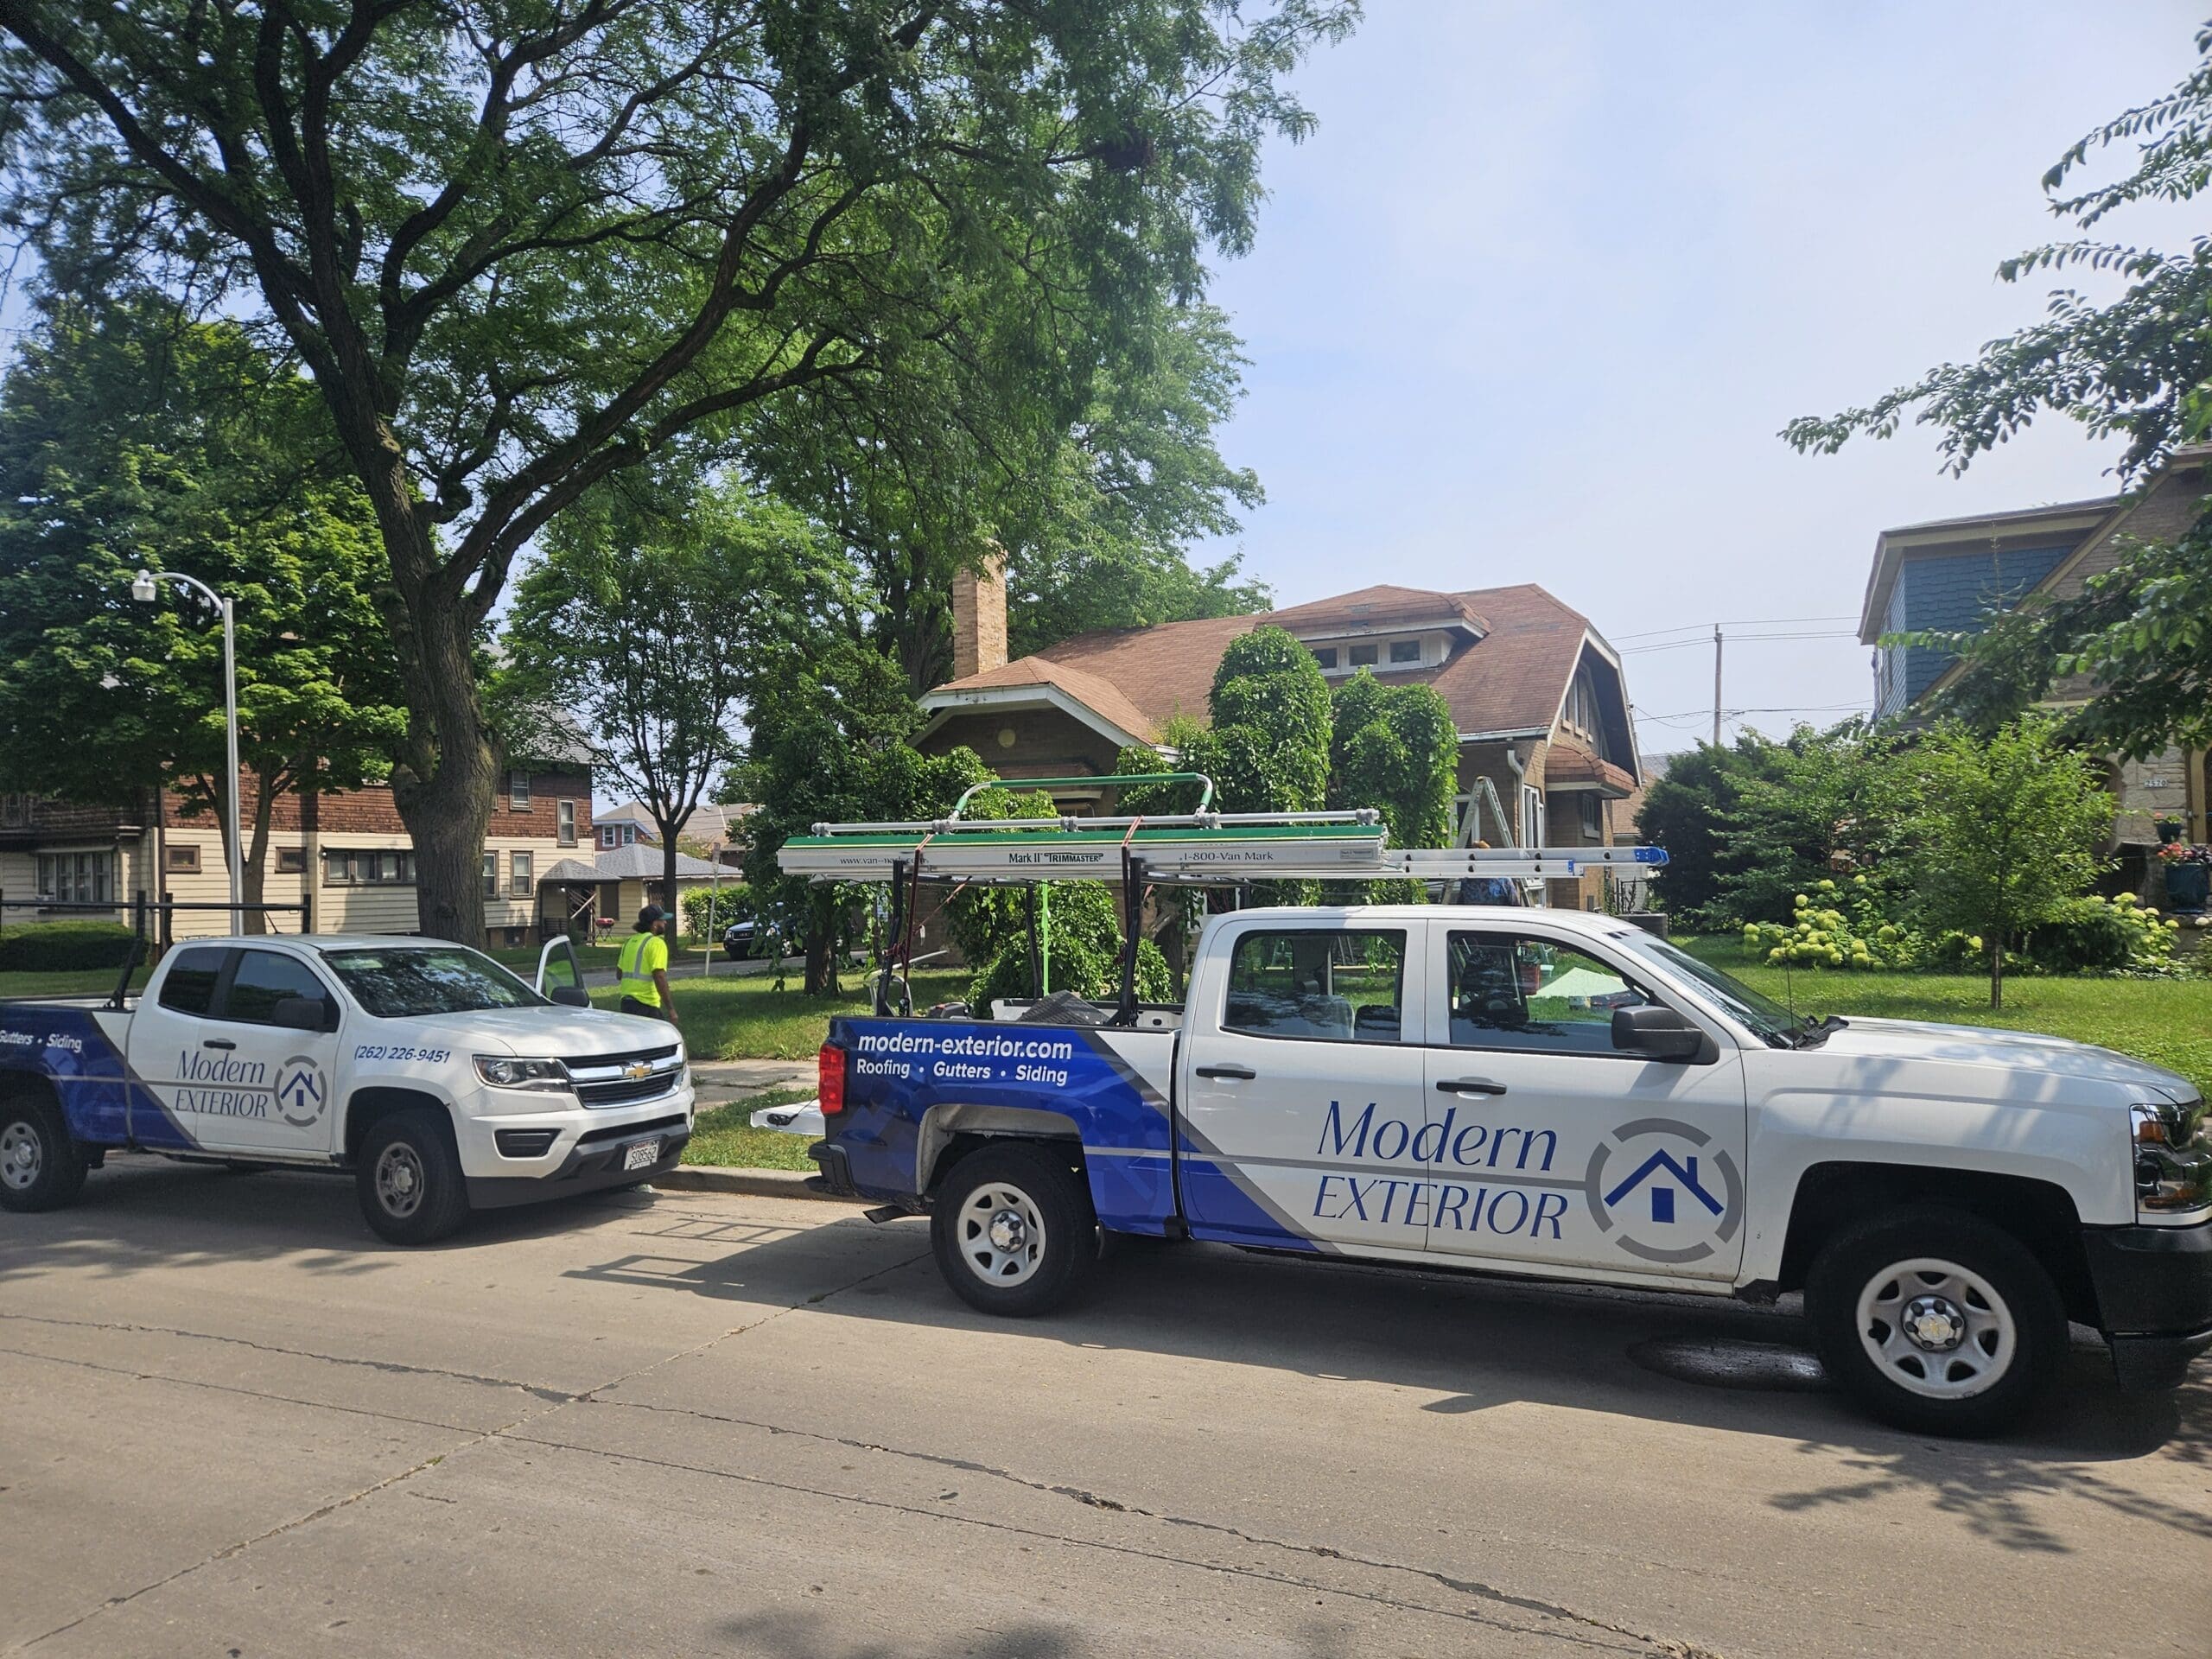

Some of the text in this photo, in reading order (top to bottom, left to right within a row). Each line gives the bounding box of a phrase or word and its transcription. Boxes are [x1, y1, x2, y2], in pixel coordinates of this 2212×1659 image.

[1008, 853, 1032, 863] Mark
[1184, 851, 1274, 861] 1-800-Van Mark
[0, 1029, 82, 1053] Gutters Siding
[354, 1045, 451, 1064] (262) 226-9451
[857, 1033, 1072, 1059] modern-exterior.com
[175, 1050, 265, 1084] Modern
[856, 1058, 1068, 1087] Roofing Gutters Siding
[175, 1089, 268, 1117] EXTERIOR
[1317, 1100, 1557, 1171] Modern
[1313, 1175, 1568, 1239] EXTERIOR
